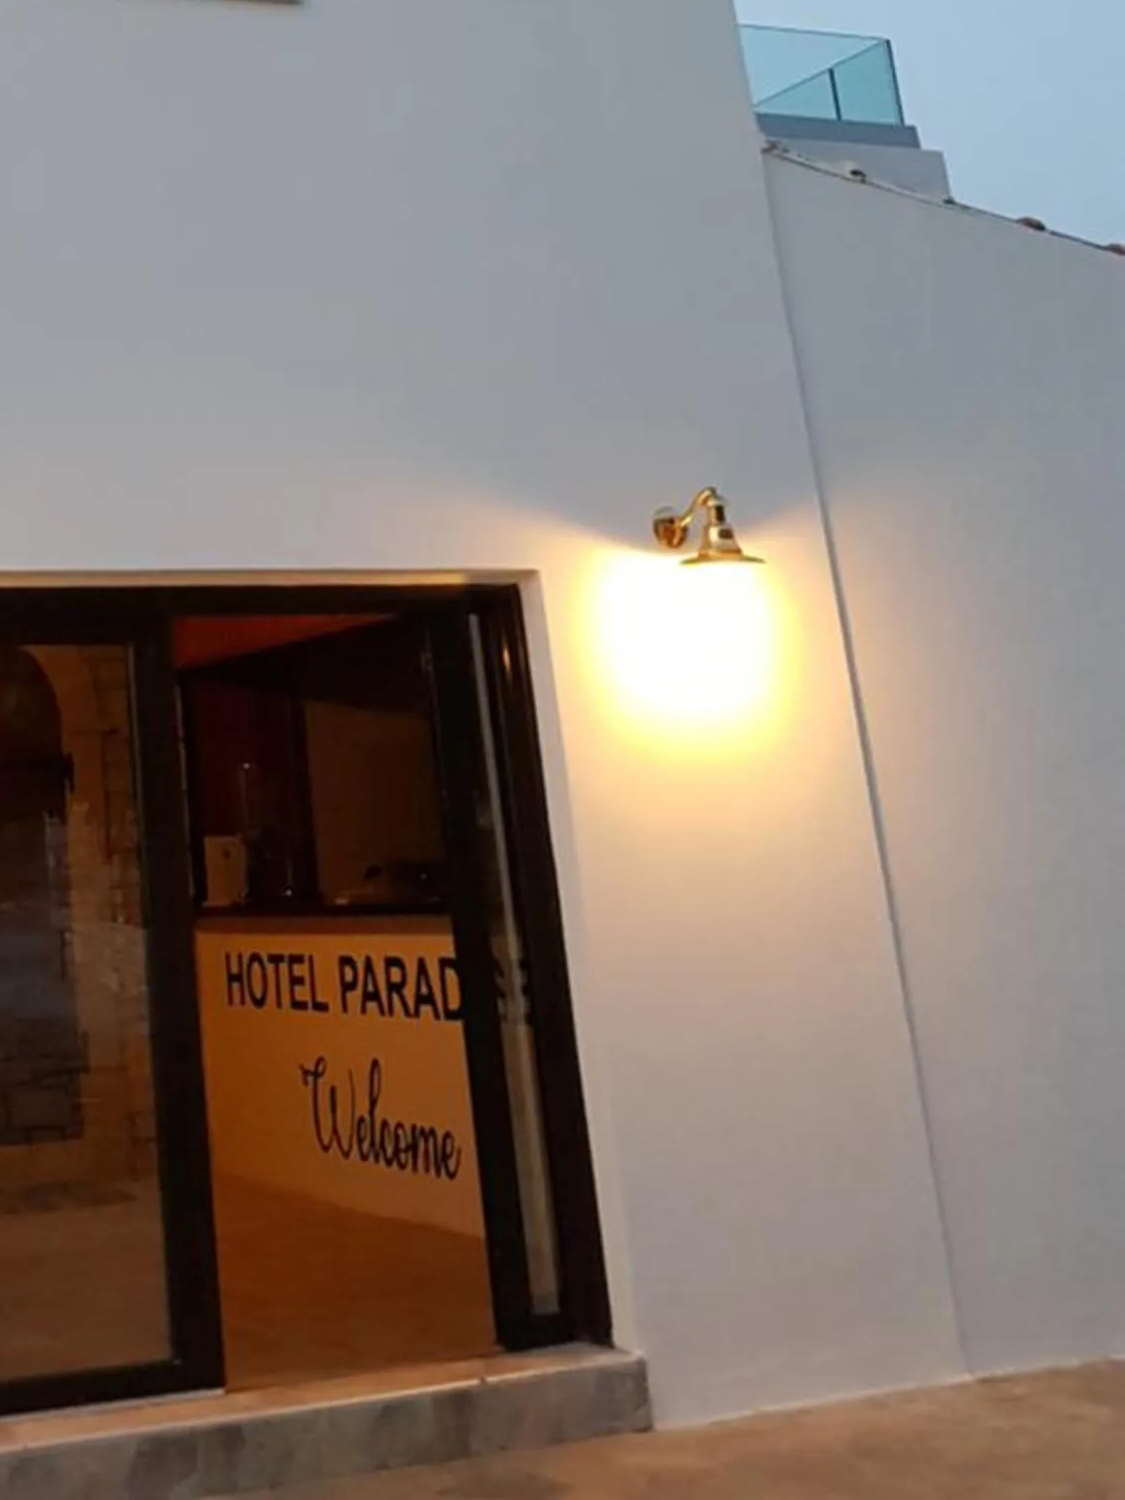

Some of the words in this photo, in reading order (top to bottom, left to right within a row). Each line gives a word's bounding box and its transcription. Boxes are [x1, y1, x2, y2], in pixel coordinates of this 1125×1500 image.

[225, 952, 330, 1013] HOTEL
[338, 954, 465, 1021] PARAD
[298, 1056, 462, 1181] Welcome
